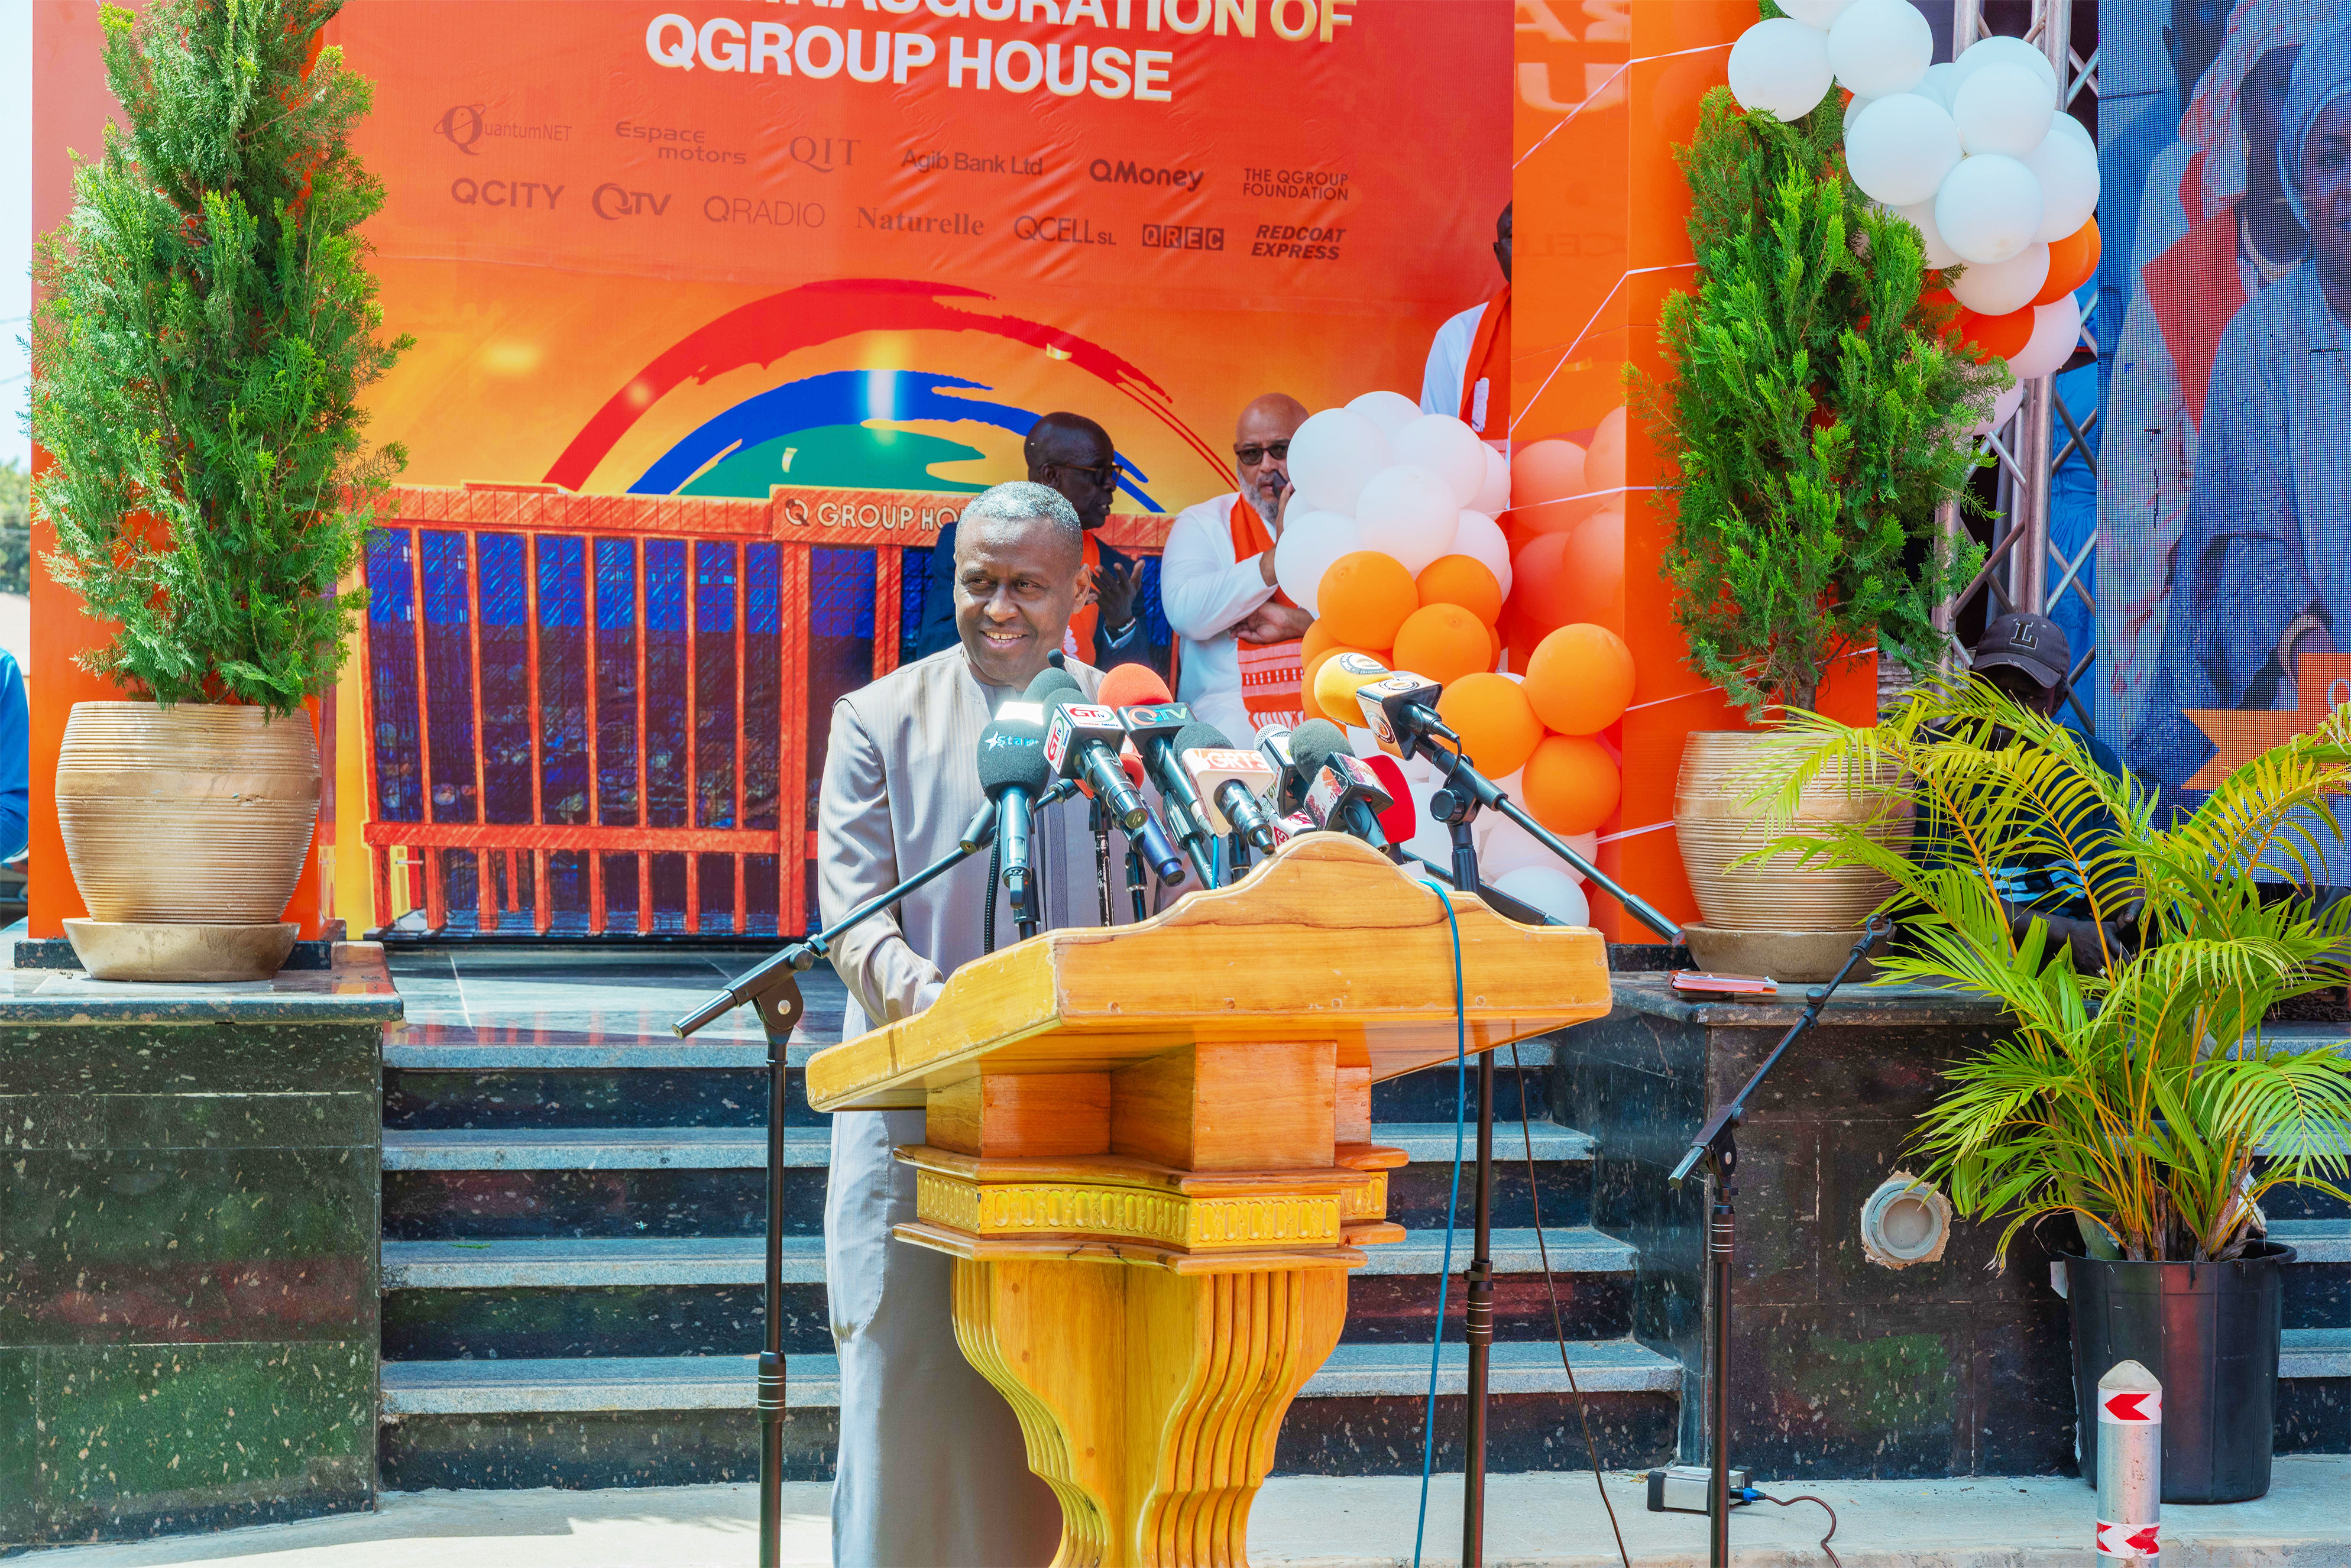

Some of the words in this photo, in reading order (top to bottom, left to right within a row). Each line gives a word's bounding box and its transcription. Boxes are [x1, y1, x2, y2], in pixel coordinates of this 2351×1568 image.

[1270, 0, 1356, 43] OF
[646, 14, 935, 84] QGROUP
[948, 37, 1173, 102] HOUSE
[616, 122, 705, 142] Espace
[658, 146, 746, 164] motors
[790, 136, 860, 173] QIT
[901, 150, 949, 173] Agib
[954, 152, 1006, 174] Bank
[1011, 156, 1042, 176] Ltd
[1089, 159, 1204, 192] QMoney
[1245, 169, 1271, 182] THE
[1277, 170, 1349, 186] QGROUP
[451, 178, 565, 210] QCITY
[592, 183, 673, 221] QTV
[1243, 183, 1348, 200] FOUNDATION
[704, 196, 825, 228] QRADIO
[855, 207, 985, 236] Naturelle
[1014, 216, 1094, 244] QCELL
[1142, 224, 1224, 251] QREC
[1256, 225, 1346, 242] REDCOAT
[1251, 242, 1340, 260] EXPRESS
[817, 503, 915, 530] GROUP
[921, 507, 963, 532] HO
[2010, 618, 2038, 650] L
[1128, 707, 1187, 725] QTV
[1207, 752, 1268, 769] GRTS
